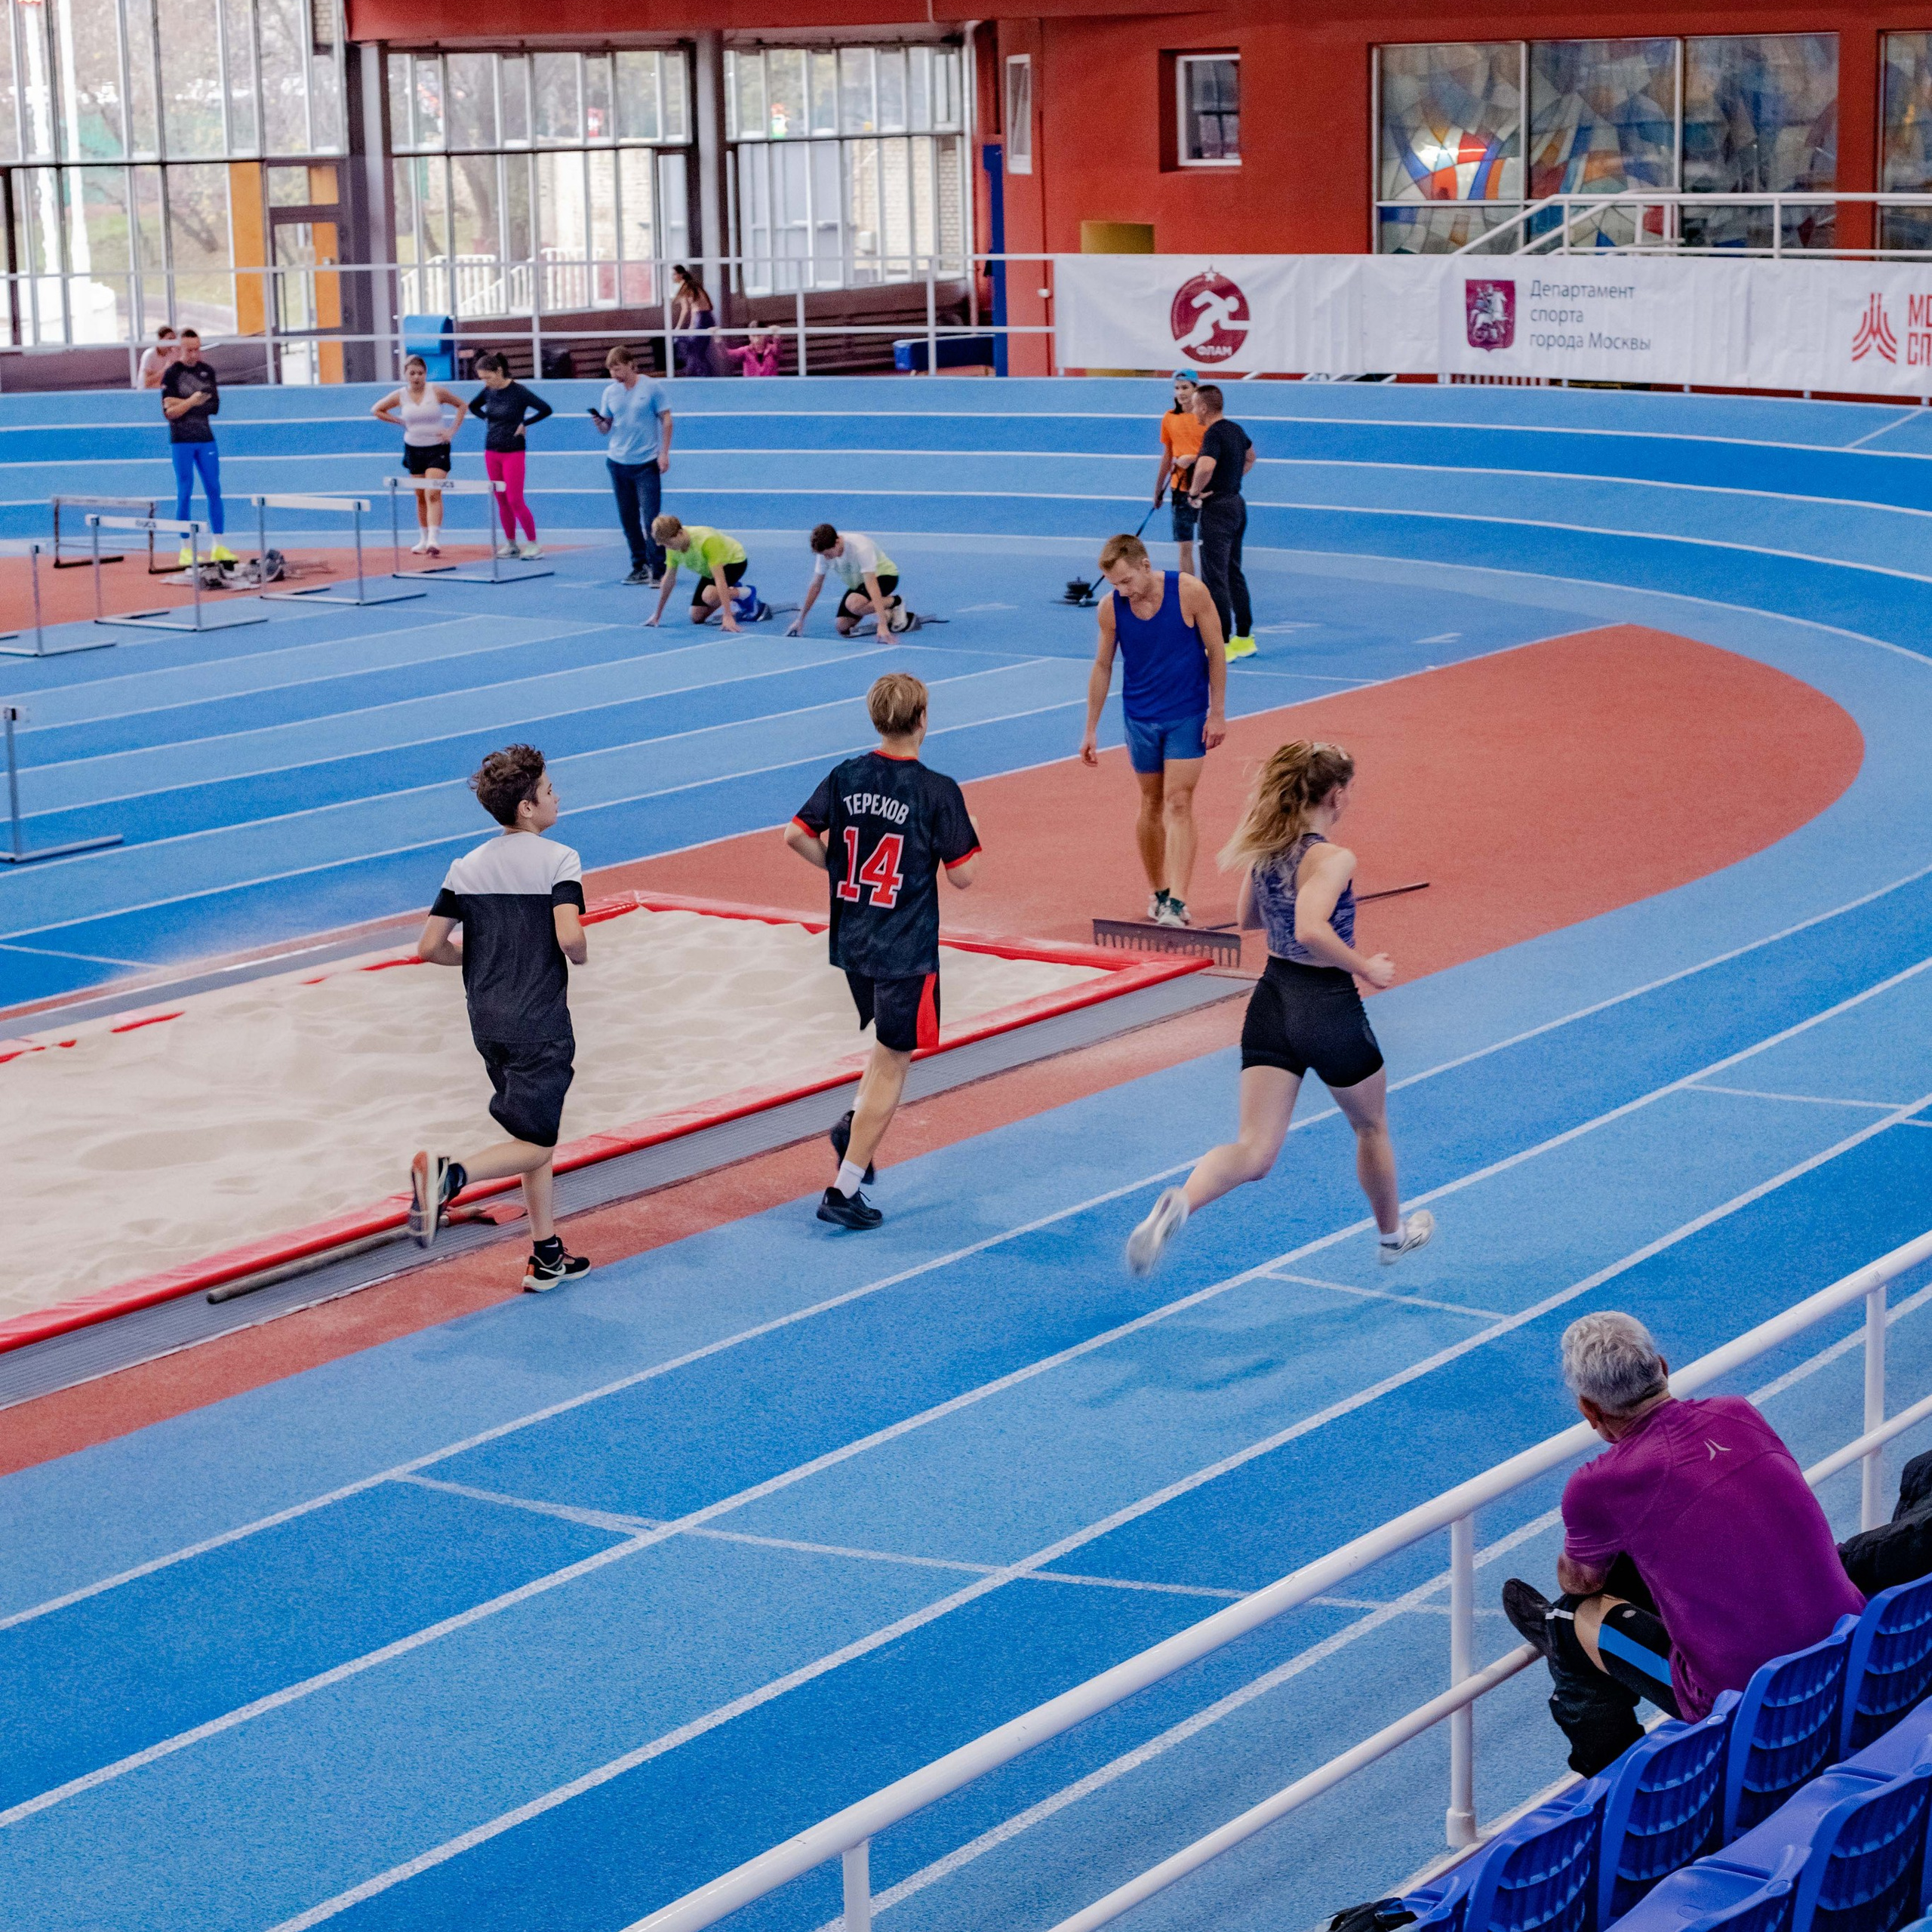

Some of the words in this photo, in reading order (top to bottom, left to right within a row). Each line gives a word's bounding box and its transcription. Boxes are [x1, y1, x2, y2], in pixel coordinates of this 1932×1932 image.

[1531, 280, 1635, 300] Департамент
[1530, 309, 1584, 326] спорта
[1196, 345, 1232, 356] ФЛАМ
[1530, 334, 1584, 350] города
[1588, 332, 1651, 350] Москвы
[843, 793, 909, 825] ТЕРЕХОВ
[836, 826, 904, 909] 14
